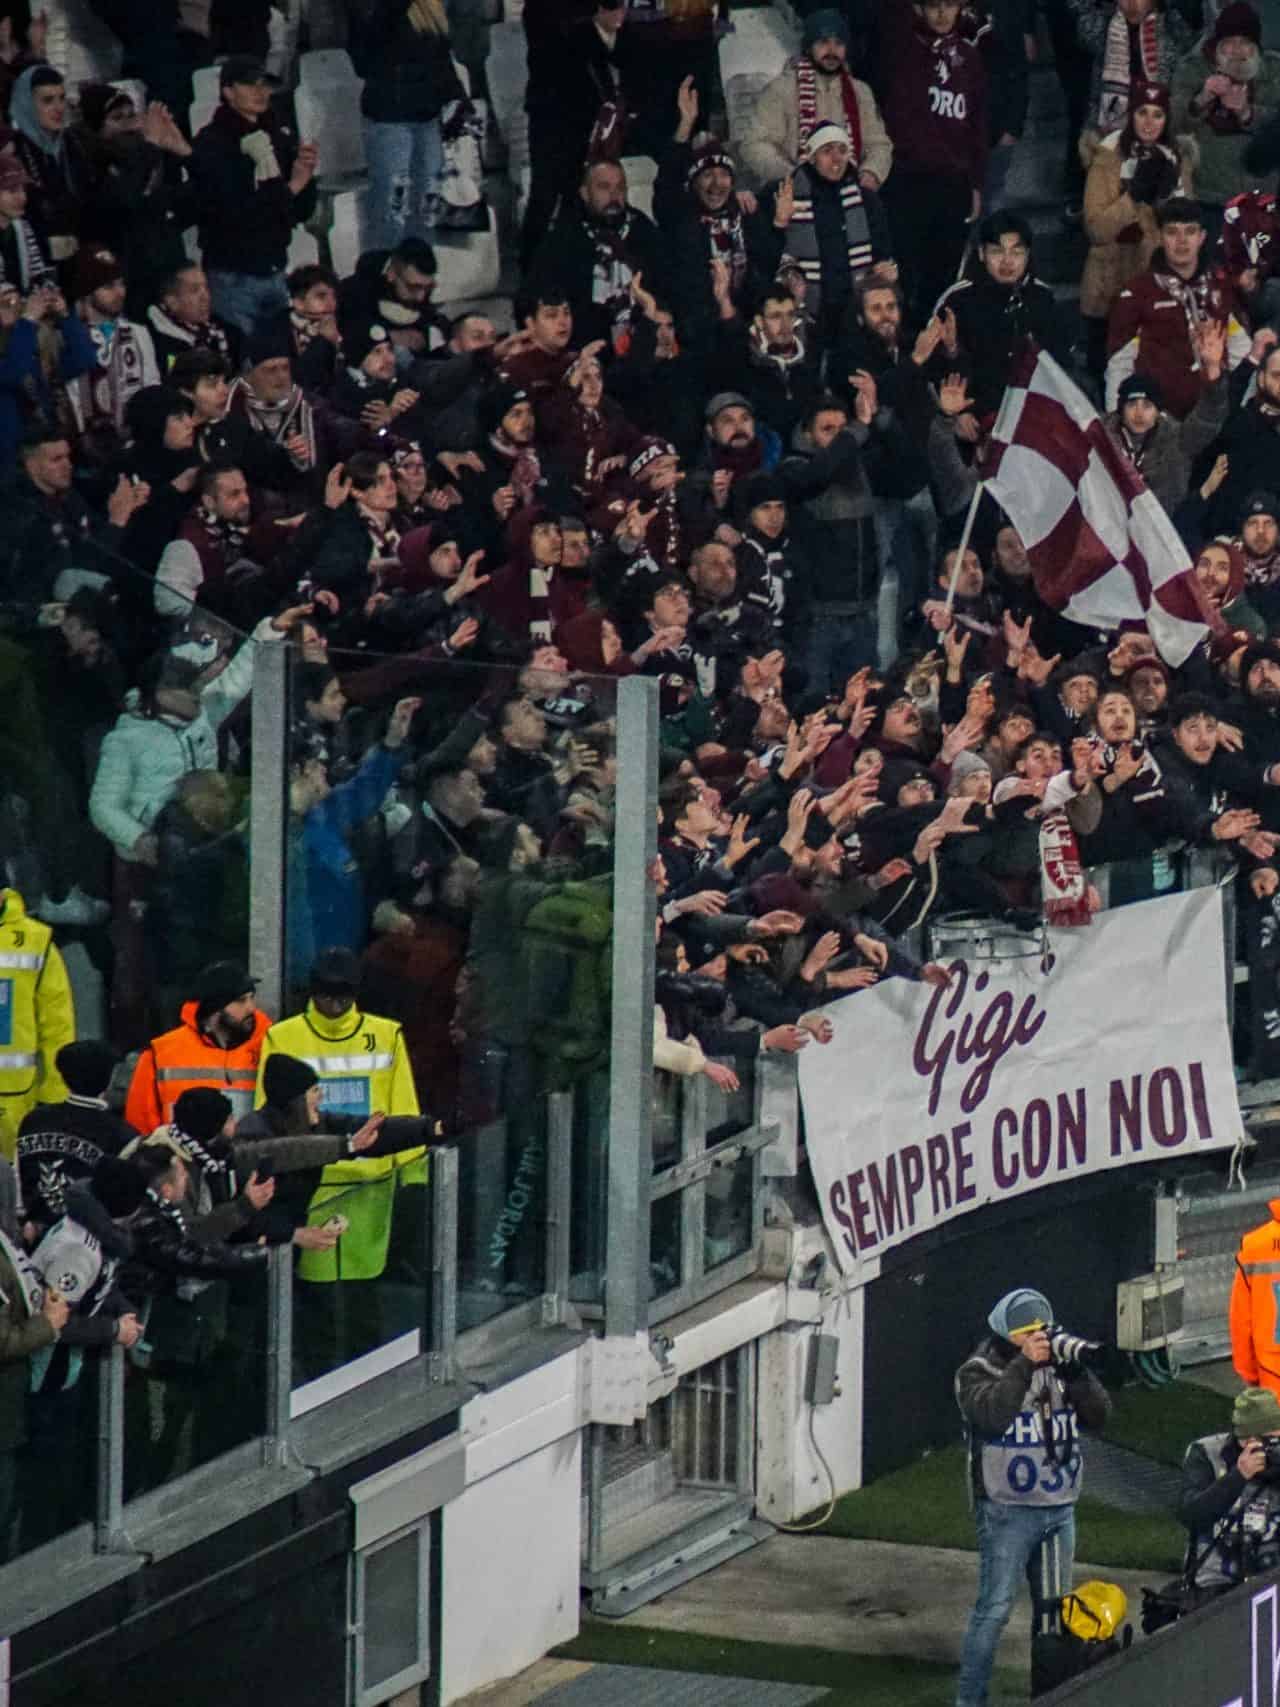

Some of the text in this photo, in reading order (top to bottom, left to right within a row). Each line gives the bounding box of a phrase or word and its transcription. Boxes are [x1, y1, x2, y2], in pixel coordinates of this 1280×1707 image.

[913, 958, 1055, 1117] Gigi
[829, 1062, 1214, 1259] SEMPRE CON NOI
